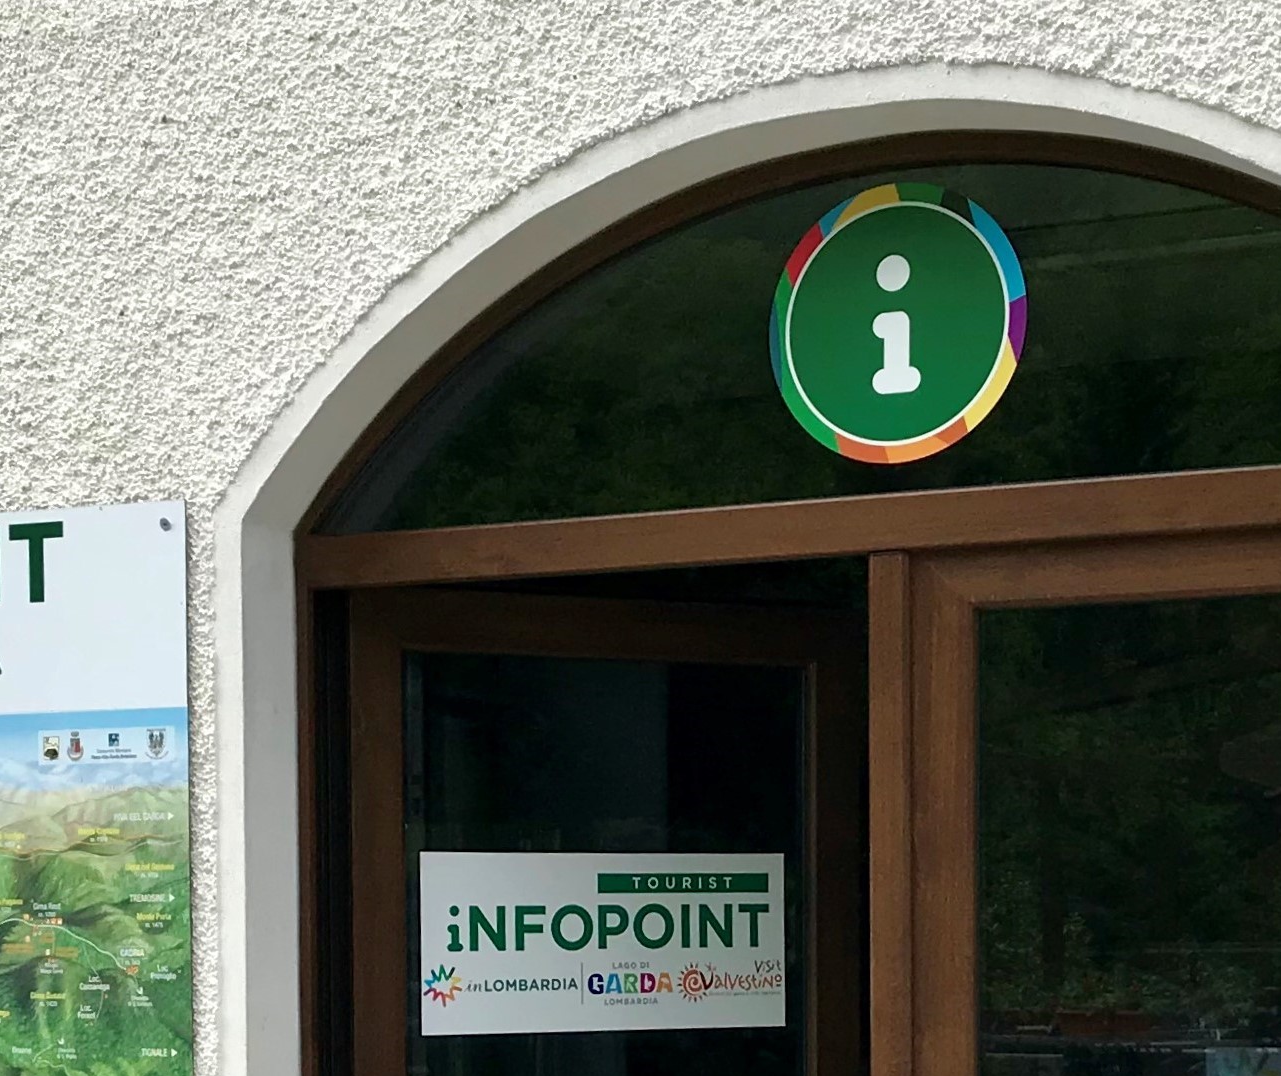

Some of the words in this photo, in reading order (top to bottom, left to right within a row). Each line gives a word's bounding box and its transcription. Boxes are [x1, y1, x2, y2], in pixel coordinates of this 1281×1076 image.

[632, 875, 734, 889] TOURIST
[587, 973, 673, 994] GARDA
[604, 997, 658, 1005] LOMBARDIA
